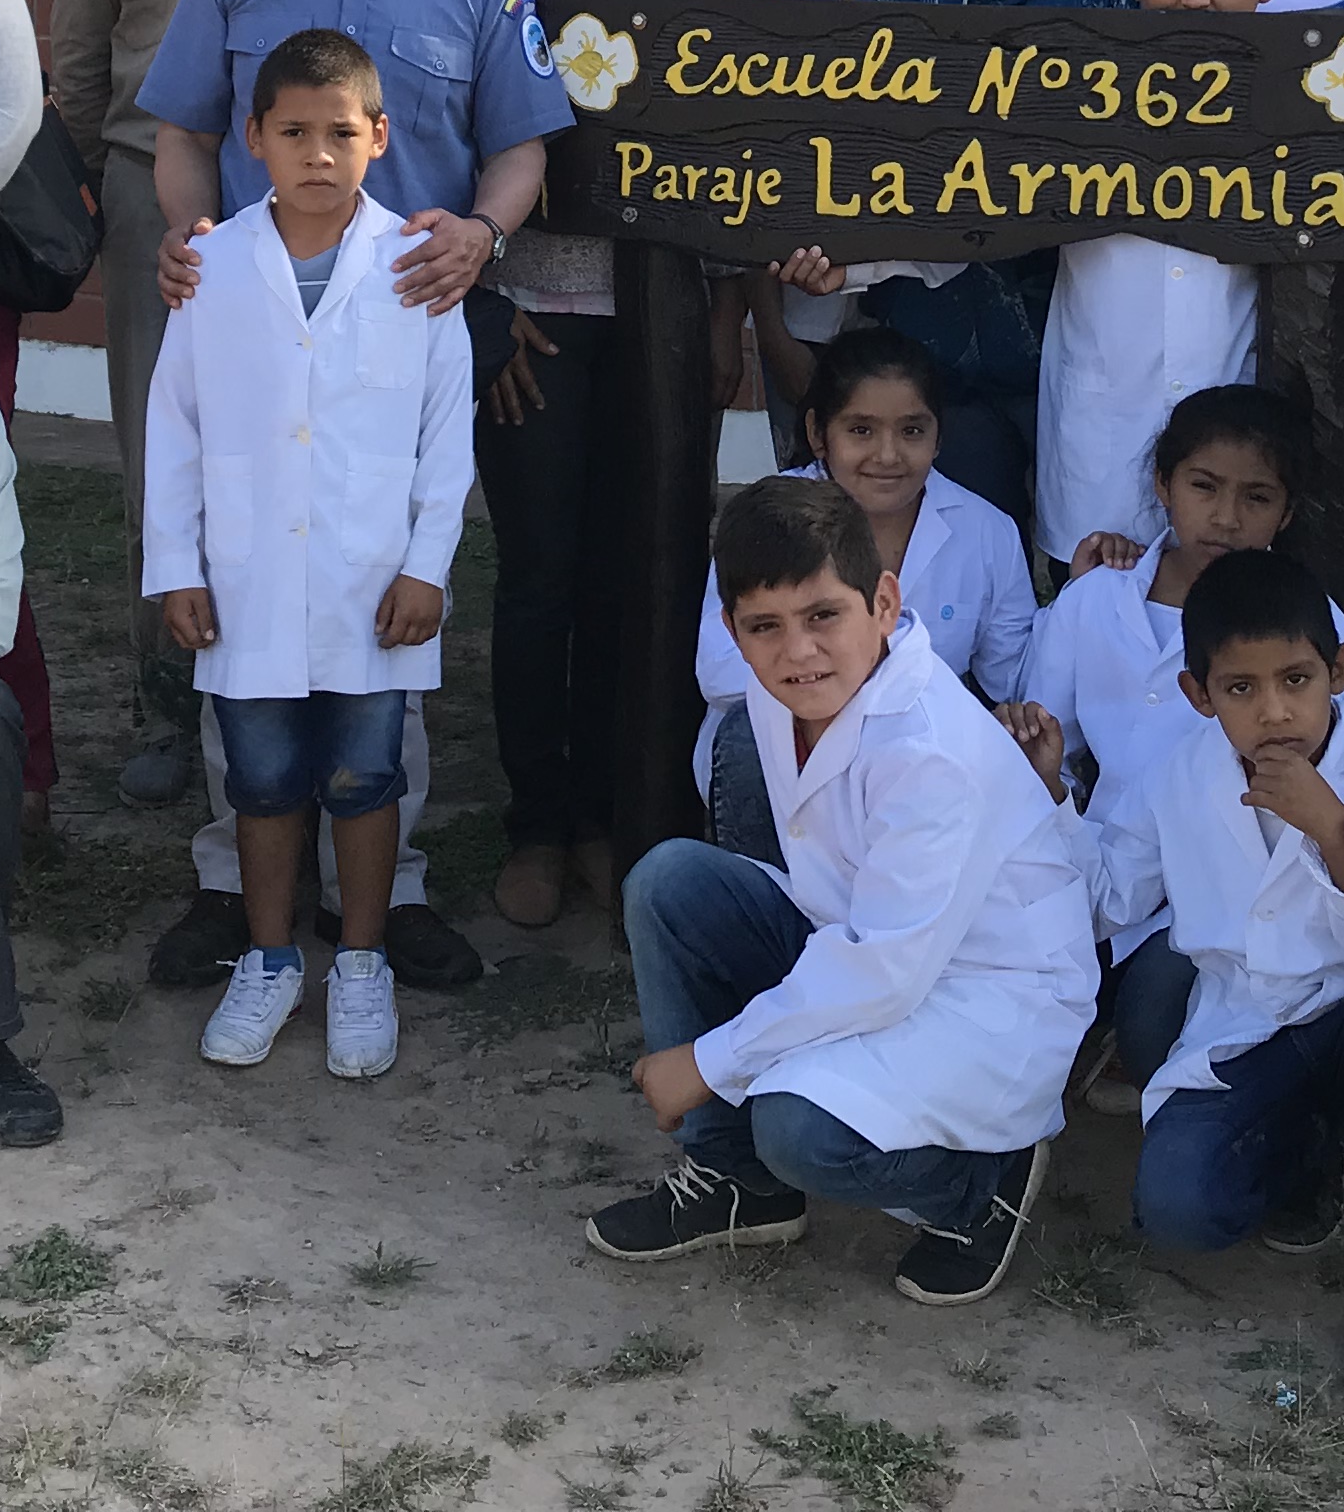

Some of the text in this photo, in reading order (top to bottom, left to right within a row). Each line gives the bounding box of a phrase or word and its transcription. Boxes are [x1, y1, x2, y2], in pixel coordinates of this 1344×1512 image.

[665, 28, 941, 104] Escuela
[616, 142, 782, 226] Paraje
[810, 136, 913, 217] La
